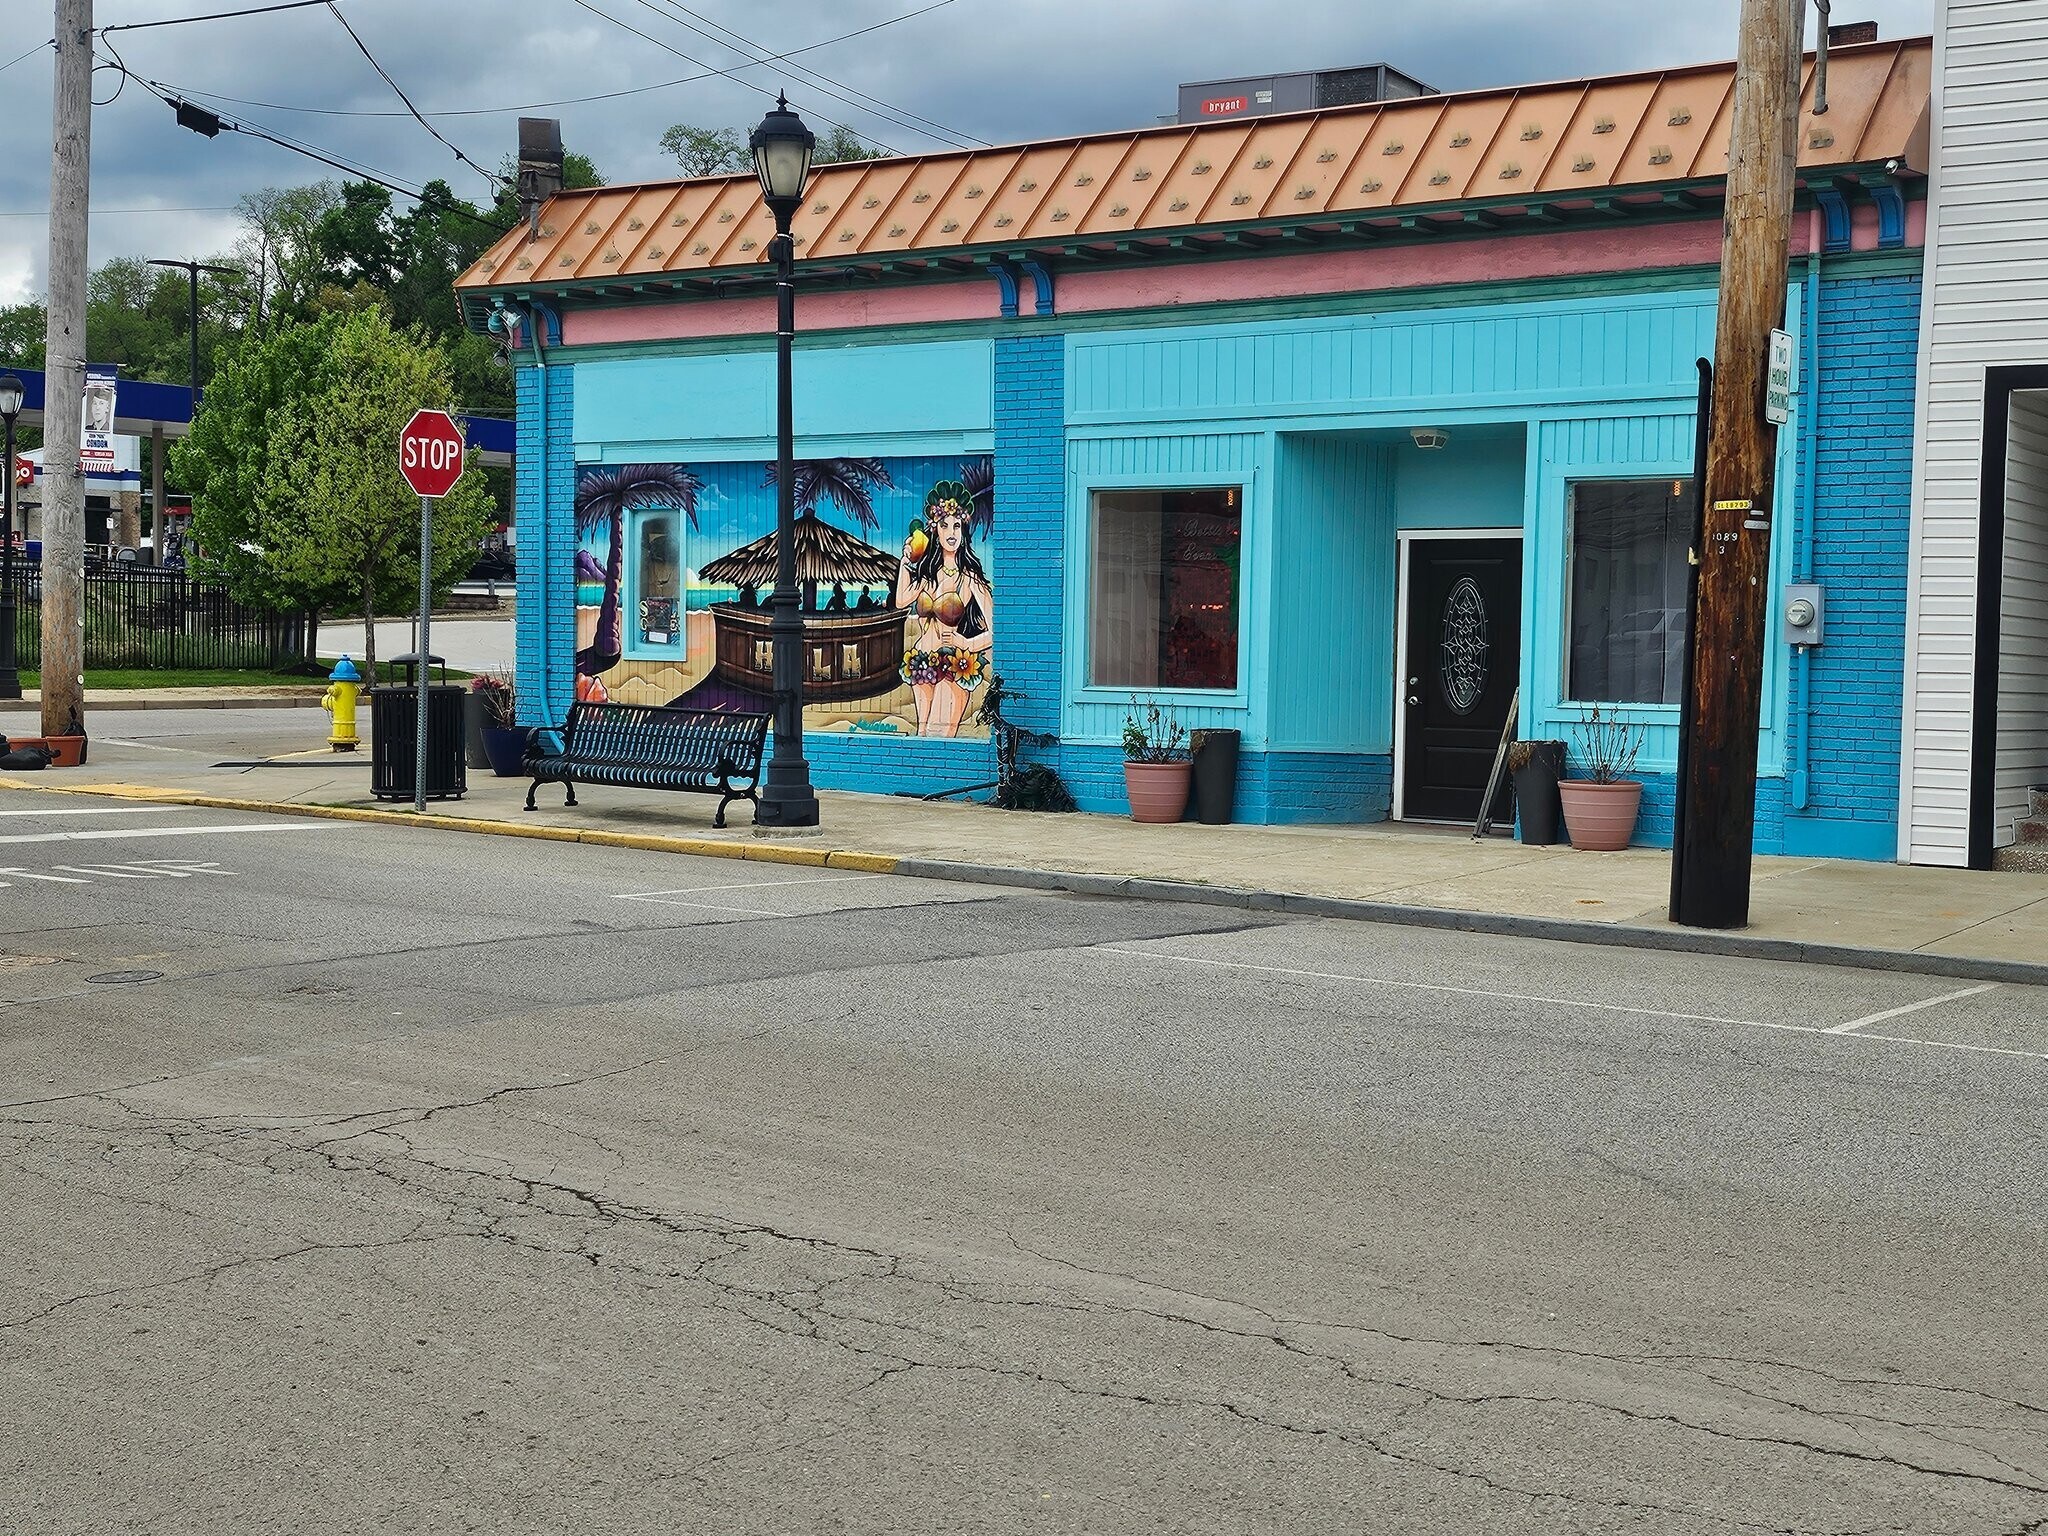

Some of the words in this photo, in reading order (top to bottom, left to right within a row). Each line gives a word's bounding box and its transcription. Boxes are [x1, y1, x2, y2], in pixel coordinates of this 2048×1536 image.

[1209, 100, 1240, 113] bryant
[1771, 368, 1788, 387] HOUR
[1768, 391, 1789, 410] PARKING
[404, 436, 459, 470] STOP
[1719, 545, 1725, 555] 3
[754, 640, 862, 681] HLA
